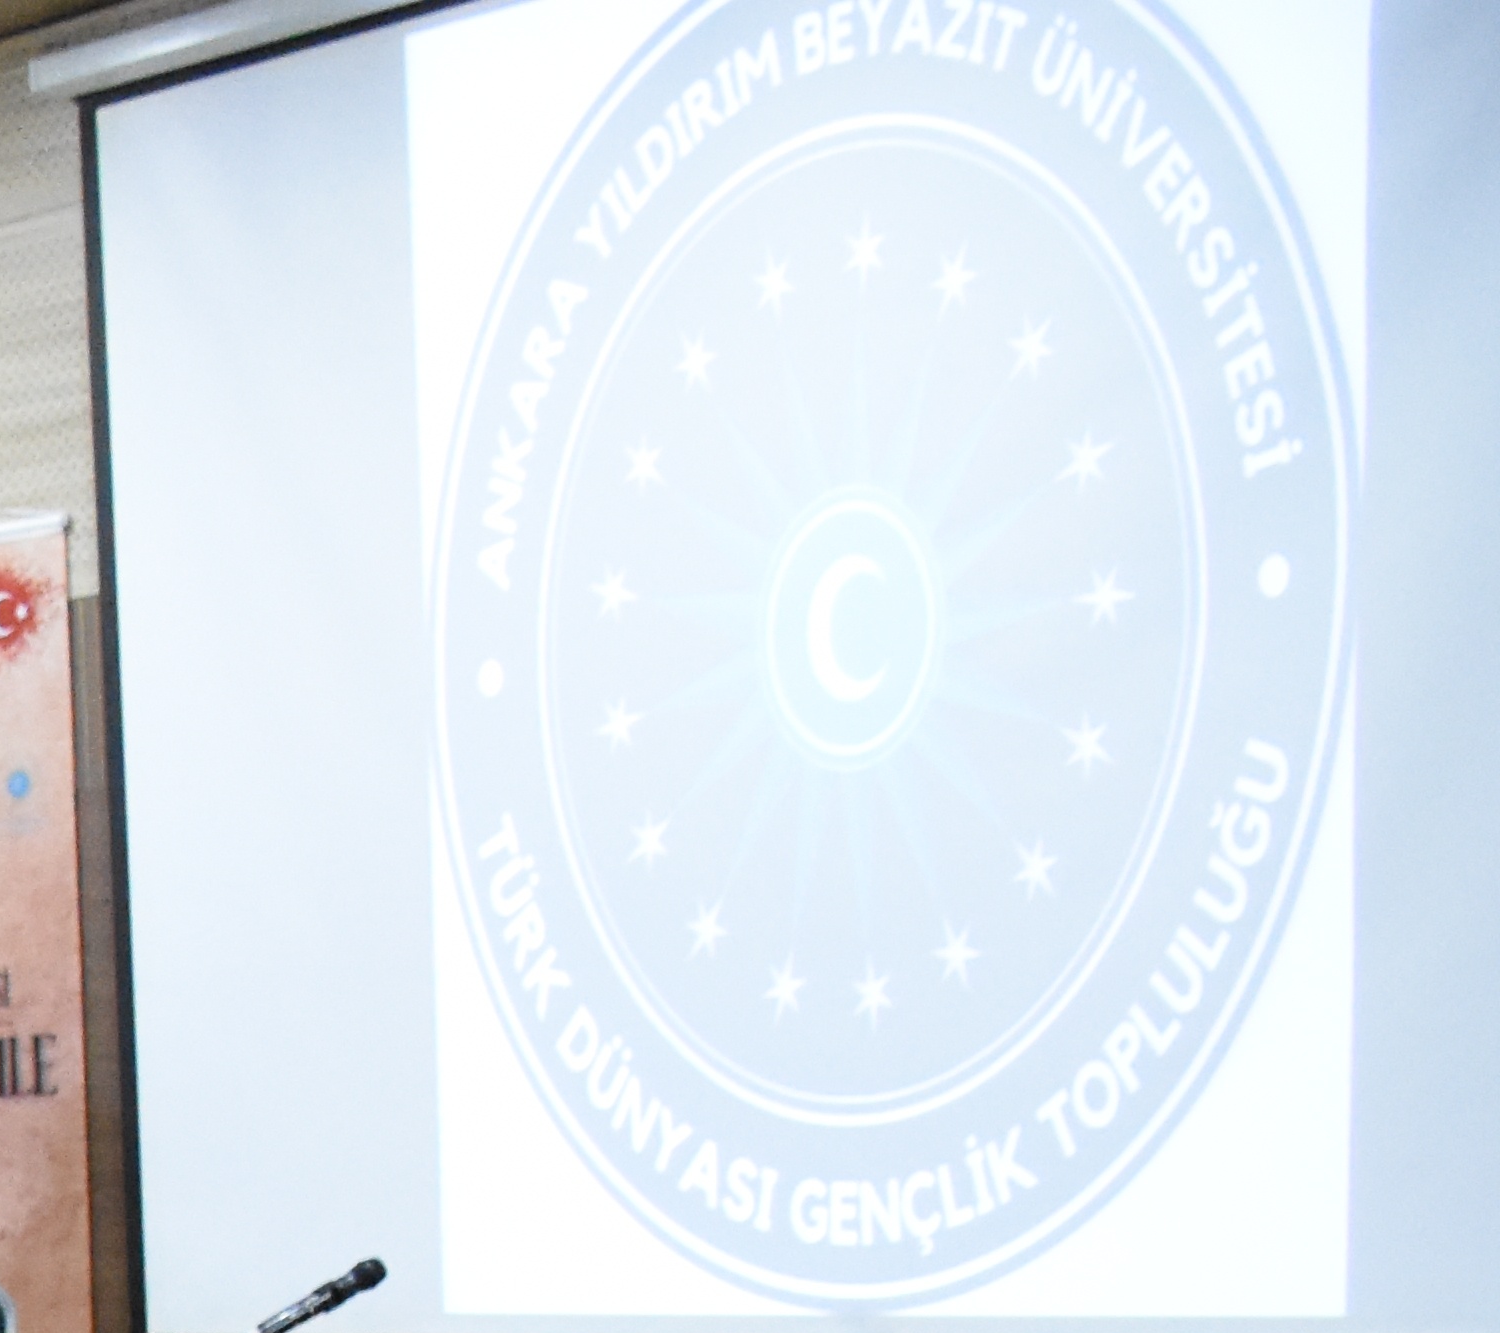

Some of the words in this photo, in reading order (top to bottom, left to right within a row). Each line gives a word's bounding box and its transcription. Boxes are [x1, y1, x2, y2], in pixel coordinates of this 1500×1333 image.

[475, 273, 590, 592] ANKARA
[572, 22, 786, 262] YILDIRIM
[790, 0, 1028, 78] BEYAZIT
[1034, 15, 1304, 478] ÜNİVERSİTESİ
[475, 812, 577, 1022] TÜRK
[555, 1003, 776, 1235] DÜNYASI
[790, 1126, 1039, 1260] GENÇLİK
[1037, 737, 1292, 1161] TOPLULUĞU
